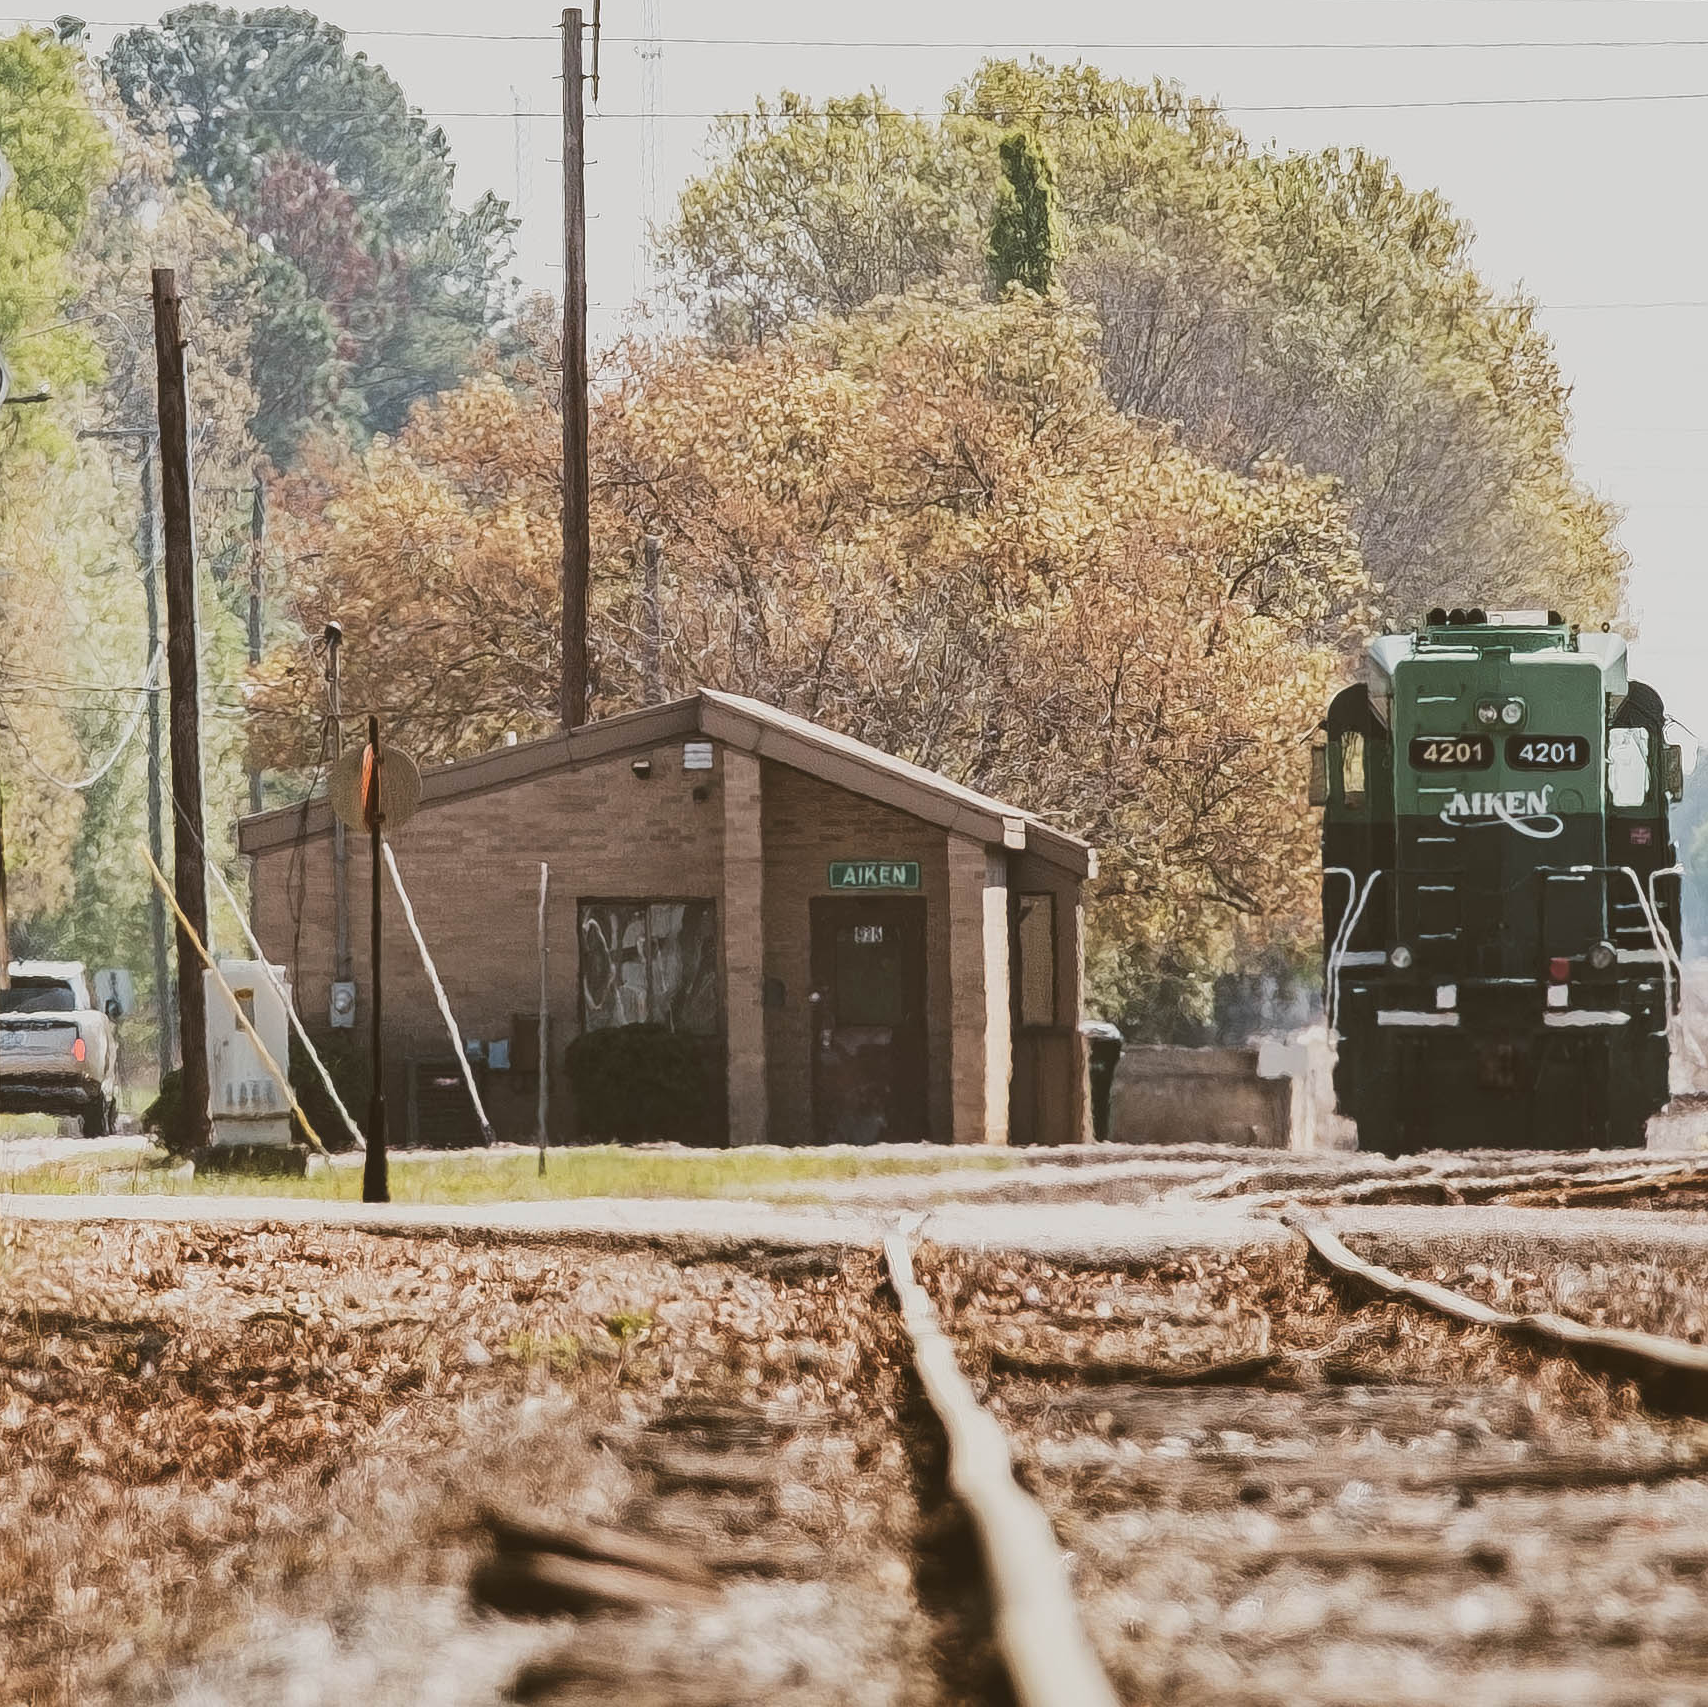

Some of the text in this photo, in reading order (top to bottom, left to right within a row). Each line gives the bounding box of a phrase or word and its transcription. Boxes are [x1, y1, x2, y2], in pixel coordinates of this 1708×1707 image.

[1423, 742, 1483, 763] 4201
[1519, 742, 1577, 763] 4201
[1440, 784, 1564, 839] AIKEN
[843, 866, 907, 885] AIKEN
